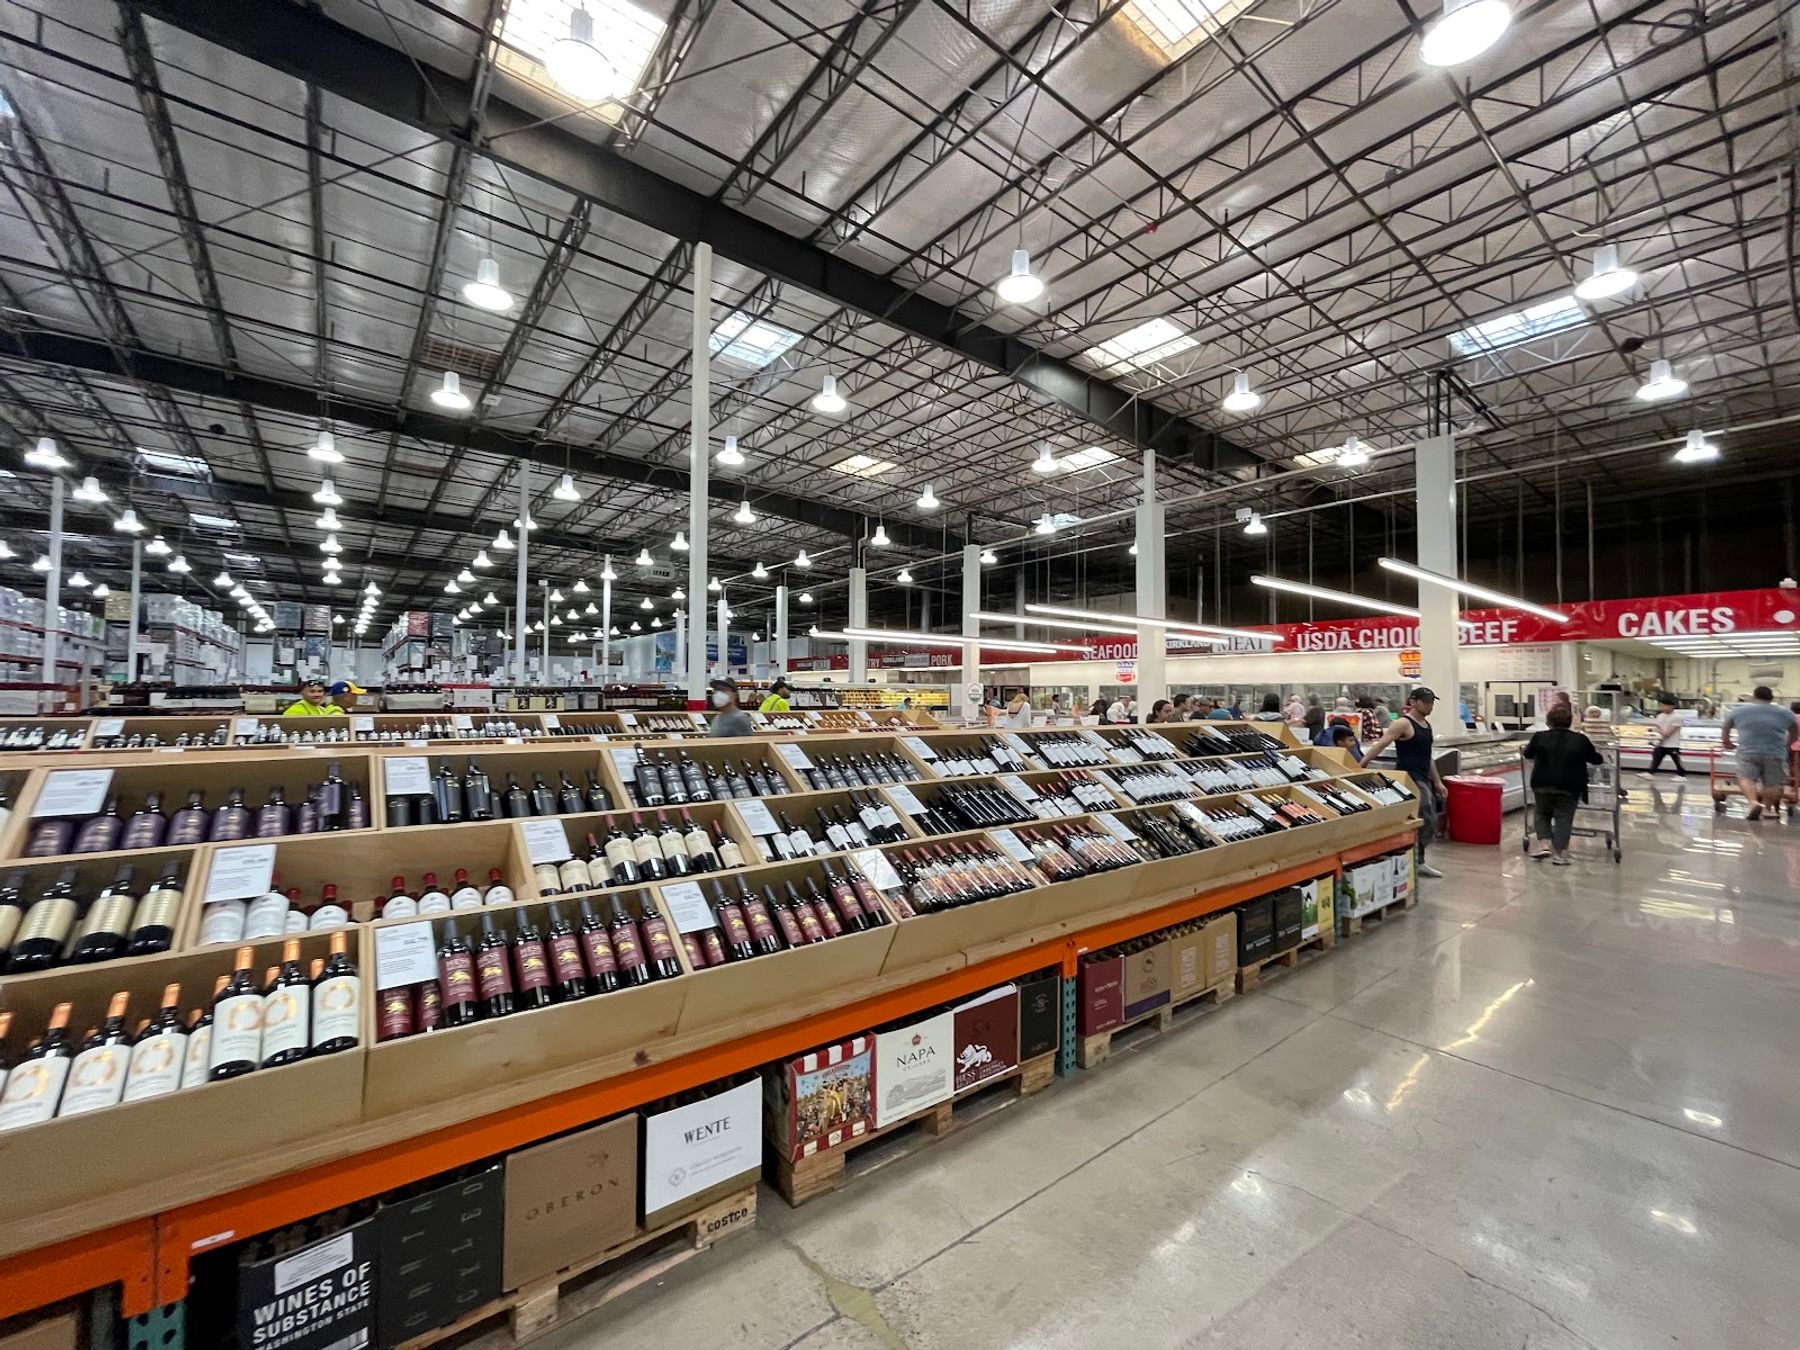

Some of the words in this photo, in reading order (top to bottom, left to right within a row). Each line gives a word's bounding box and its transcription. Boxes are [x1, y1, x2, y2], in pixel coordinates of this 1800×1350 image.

[1617, 606, 1736, 637] CAKES
[1296, 630, 1352, 652] USDA
[1358, 626, 1421, 651] CHOIC
[1458, 619, 1520, 644] BEEF
[931, 654, 953, 666] PORK
[1082, 643, 1139, 660] SEAFOOD
[896, 1045, 936, 1068] NAPA
[684, 1116, 732, 1144] WENTE
[706, 1207, 748, 1233] COSTCO
[253, 1278, 333, 1325] WINES
[341, 1261, 371, 1297] OF
[253, 1280, 371, 1344] SUBSTANCE
[336, 1297, 370, 1320] STATE
